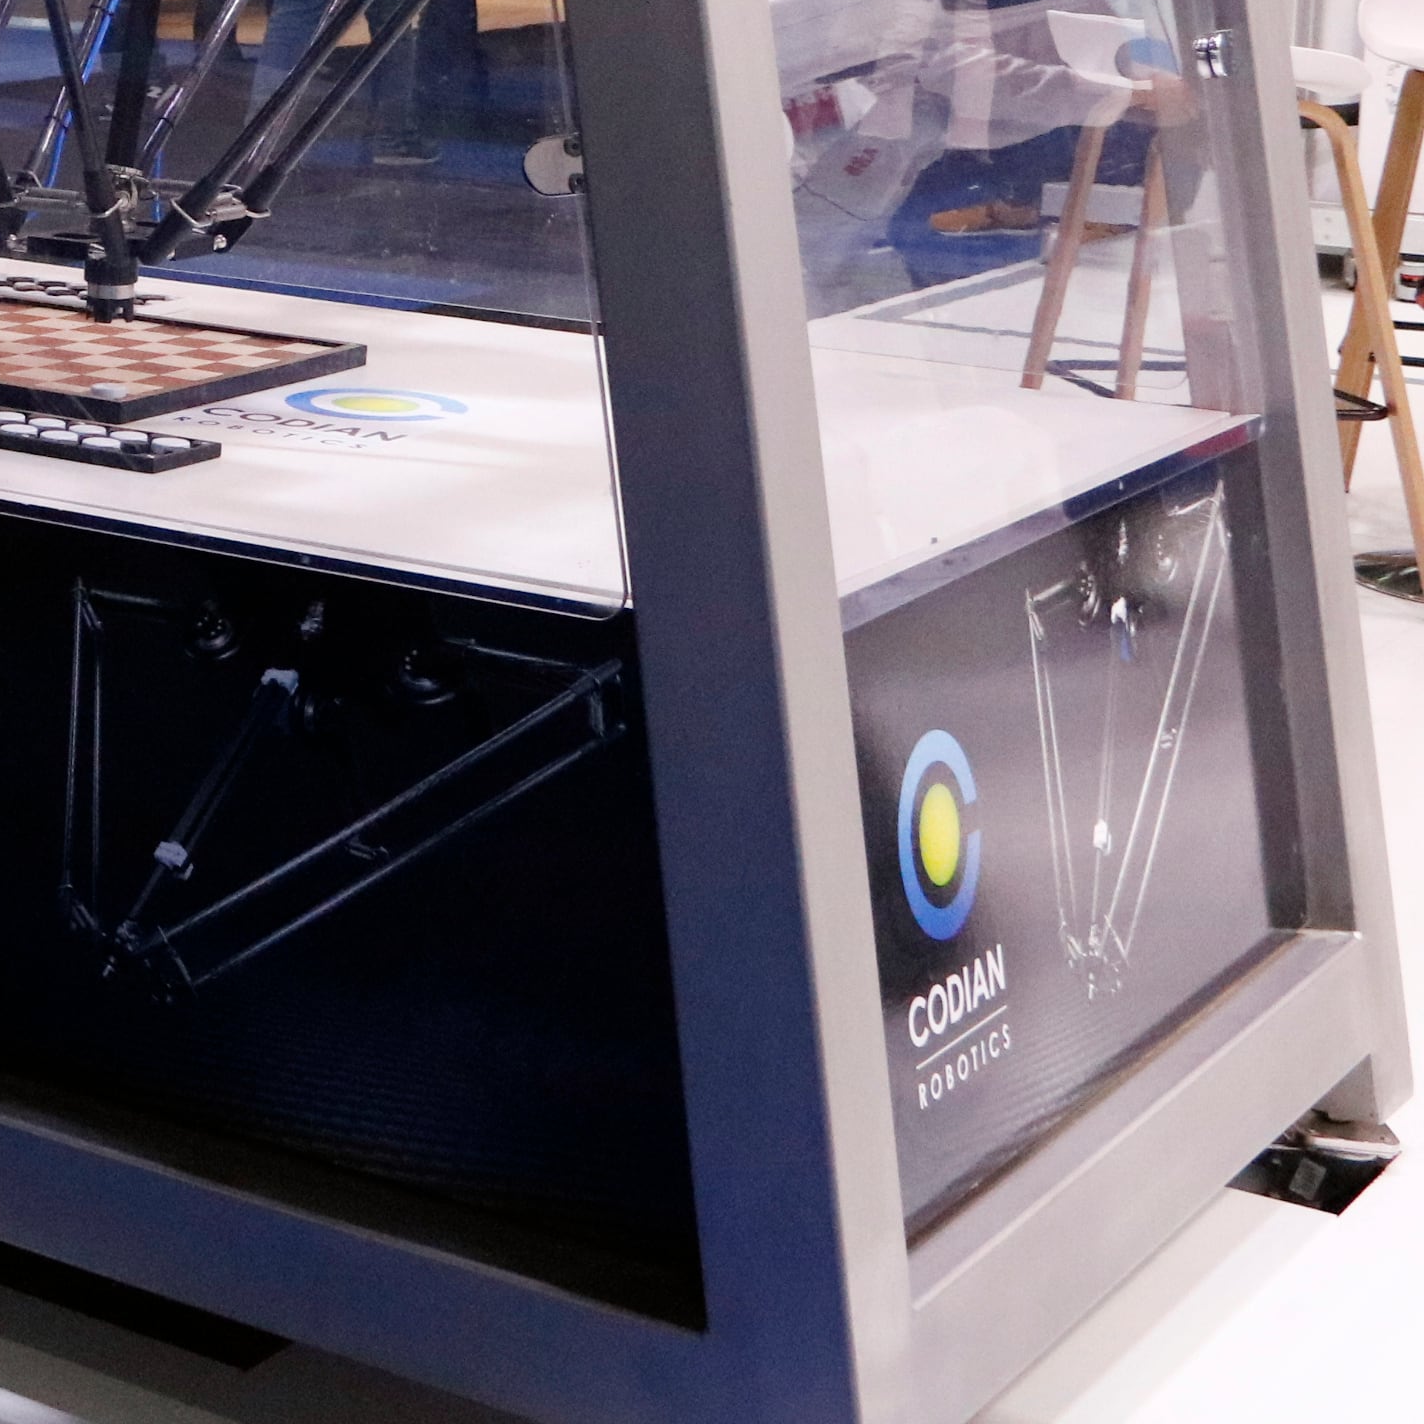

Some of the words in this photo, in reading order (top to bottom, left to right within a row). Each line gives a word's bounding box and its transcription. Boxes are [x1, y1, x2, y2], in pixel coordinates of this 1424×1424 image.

[172, 415, 369, 449] ROBOTICS
[202, 407, 408, 442] CODIAN
[908, 943, 1007, 1048] CODIAN
[918, 1023, 1012, 1110] ROBOTICS
